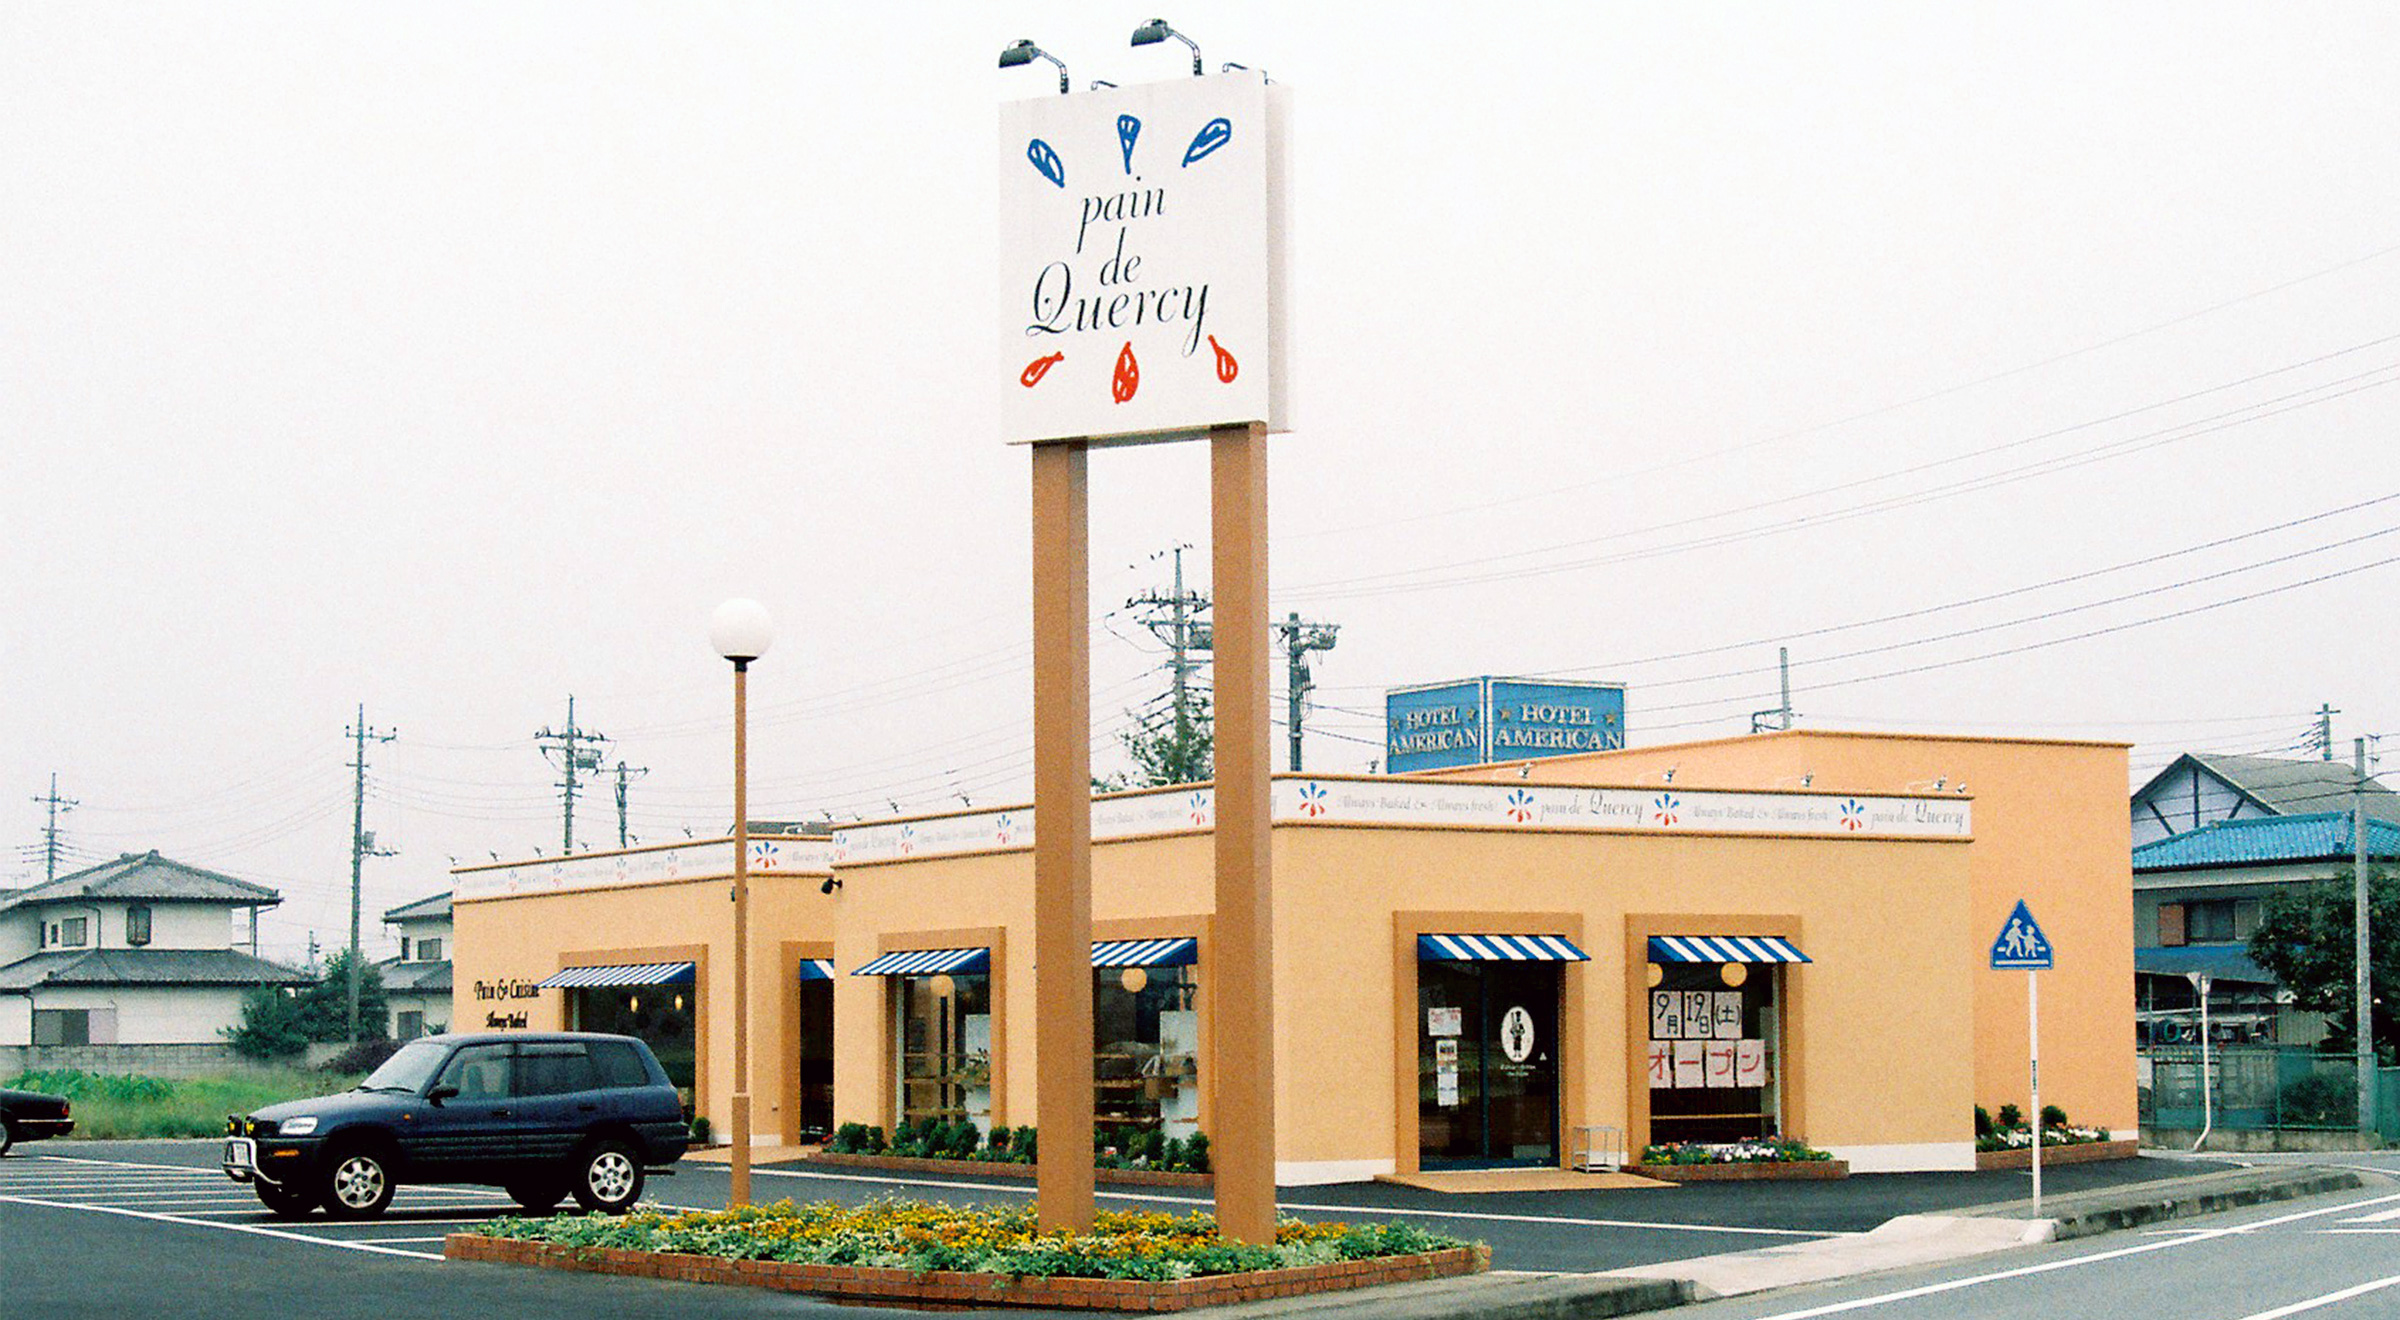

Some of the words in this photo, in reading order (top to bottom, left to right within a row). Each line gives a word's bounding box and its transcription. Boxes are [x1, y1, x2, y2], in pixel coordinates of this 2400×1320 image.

[1077, 176, 1166, 254] pain
[1099, 227, 1141, 287] de
[1025, 261, 1210, 357] Quercy
[1406, 706, 1462, 730] HOTEL
[1521, 703, 1596, 726] HOTEL
[1389, 728, 1479, 755] AMERICAN
[1495, 728, 1622, 750] AMERICAN
[1590, 792, 1644, 824] Quercy
[1915, 799, 1964, 833] Quercy
[1649, 1048, 1761, 1080] オープン
